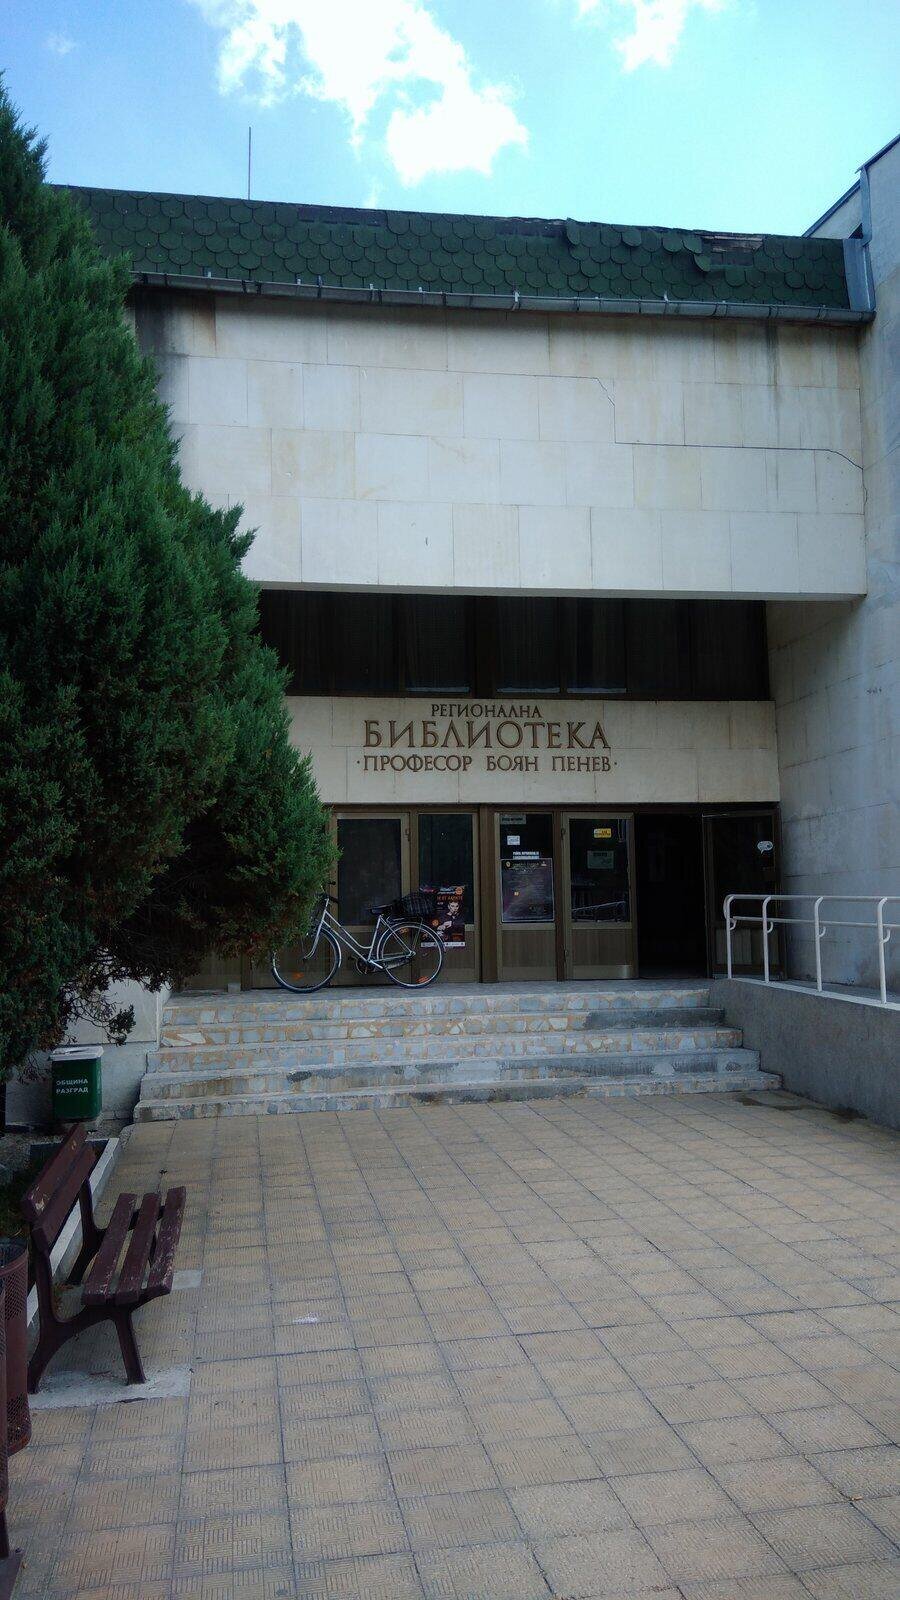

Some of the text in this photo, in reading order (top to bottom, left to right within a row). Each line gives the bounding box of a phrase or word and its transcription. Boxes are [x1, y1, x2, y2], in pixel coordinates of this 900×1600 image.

[431, 703, 544, 718] РЕГИОНАЛНА
[363, 719, 612, 749] БИБЛИОТЕКА
[363, 753, 612, 773] ПРОФЕСОР БОЯН ПЕНЕВ
[56, 1078, 88, 1086] ОБЩИНА
[56, 1086, 89, 1094] РАЗГРАД
